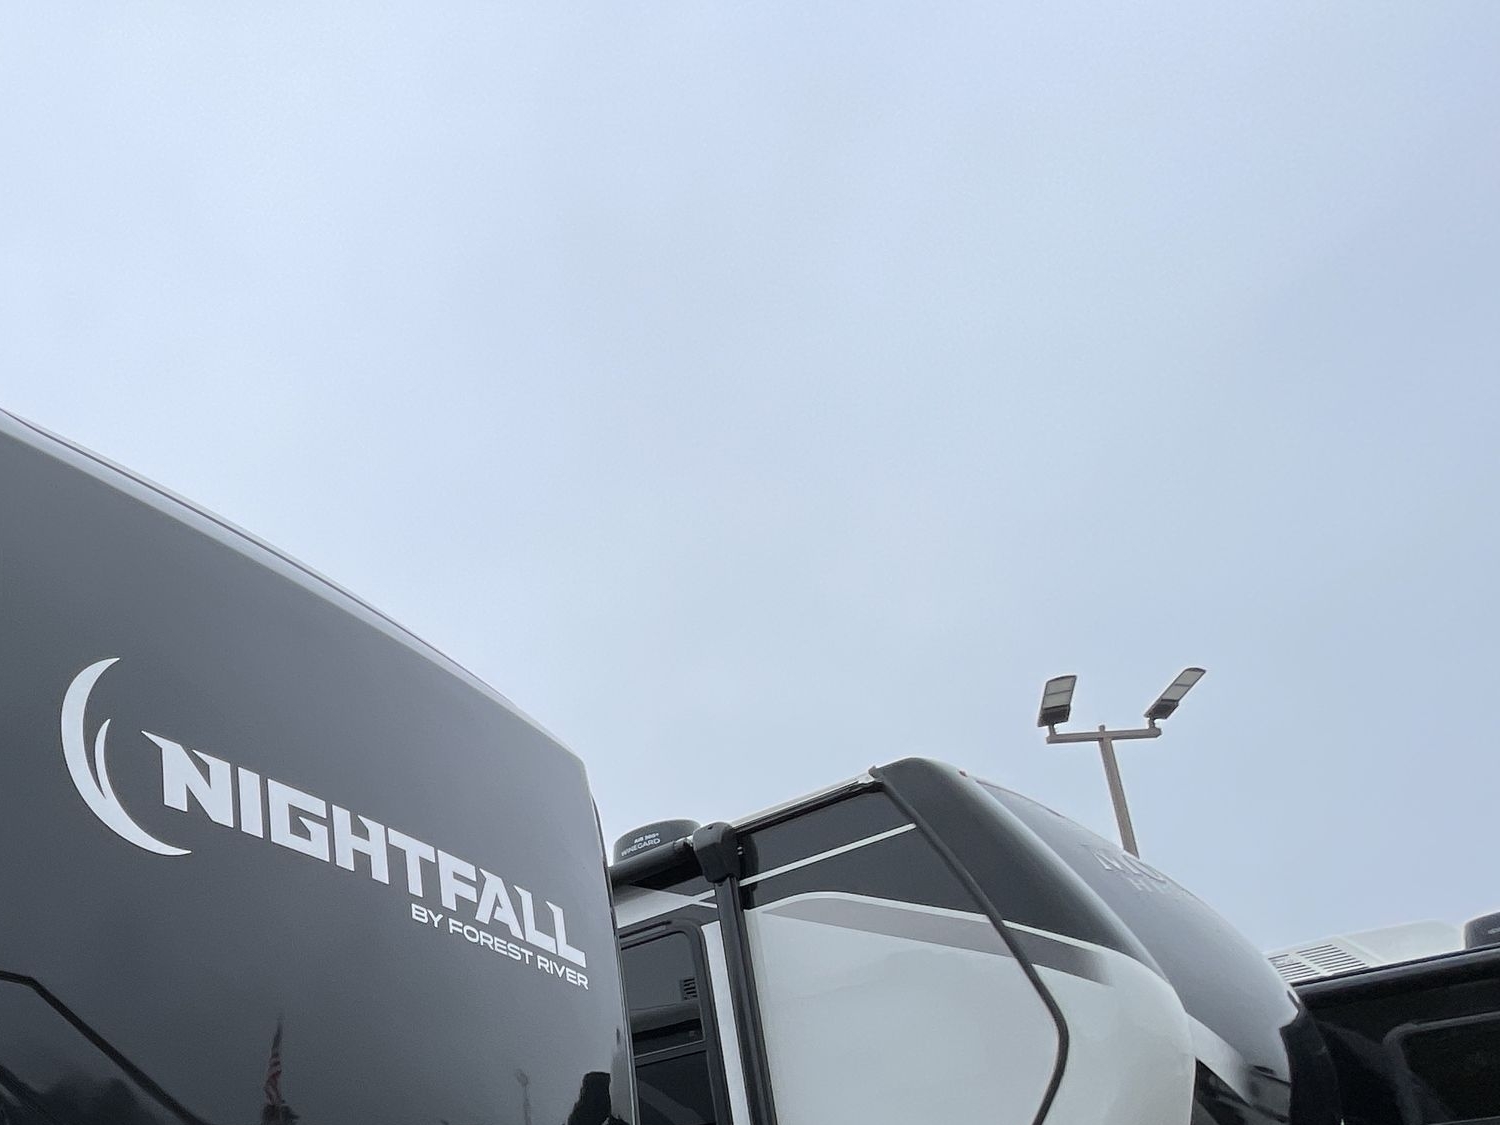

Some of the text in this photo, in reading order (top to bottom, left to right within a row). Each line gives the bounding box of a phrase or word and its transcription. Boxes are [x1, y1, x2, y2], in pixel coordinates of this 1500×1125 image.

[141, 730, 587, 969] NIGHTFALL
[621, 838, 661, 857] WINEGARD
[411, 903, 590, 990] BY FOREST RIVER
